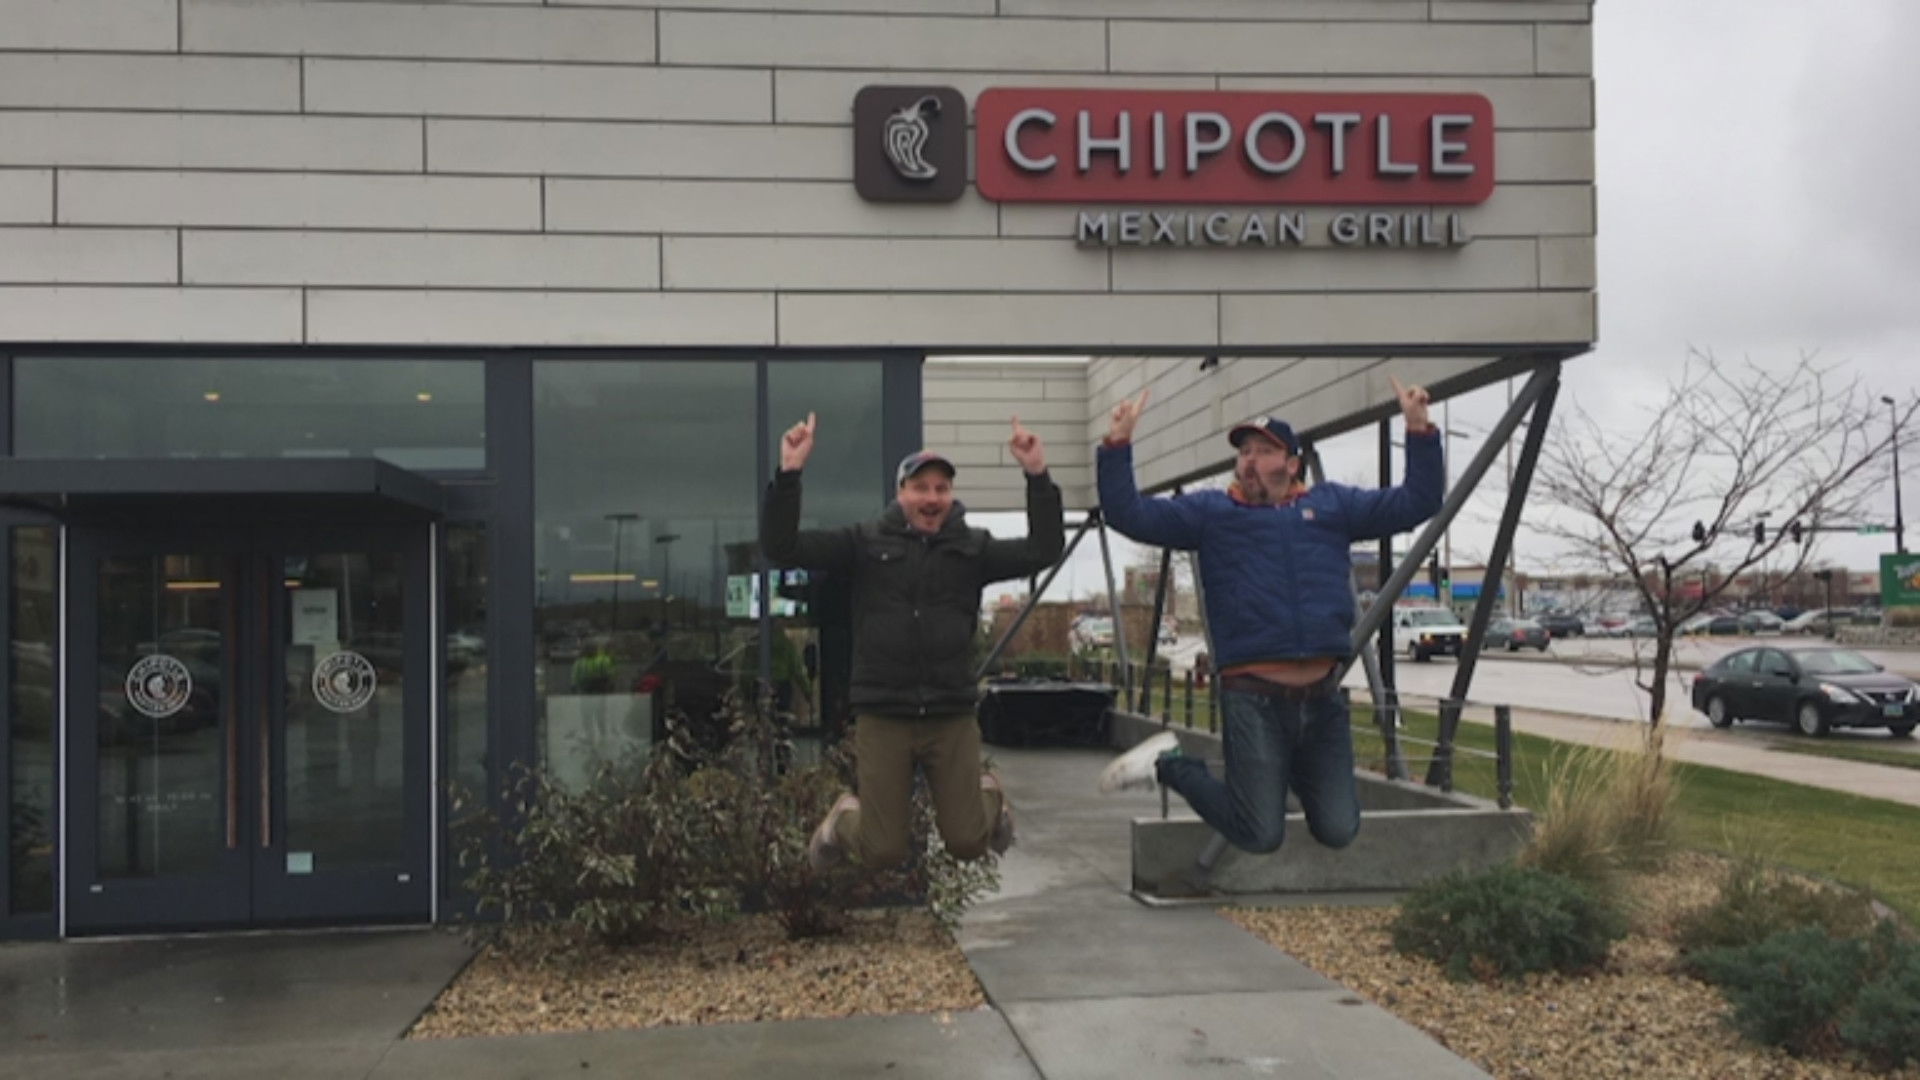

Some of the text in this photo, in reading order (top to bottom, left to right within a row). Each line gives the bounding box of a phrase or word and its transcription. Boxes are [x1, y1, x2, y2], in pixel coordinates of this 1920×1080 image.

[1003, 108, 1476, 176] CHIPOTLE
[1078, 210, 1471, 245] MEXICAN GRILL
